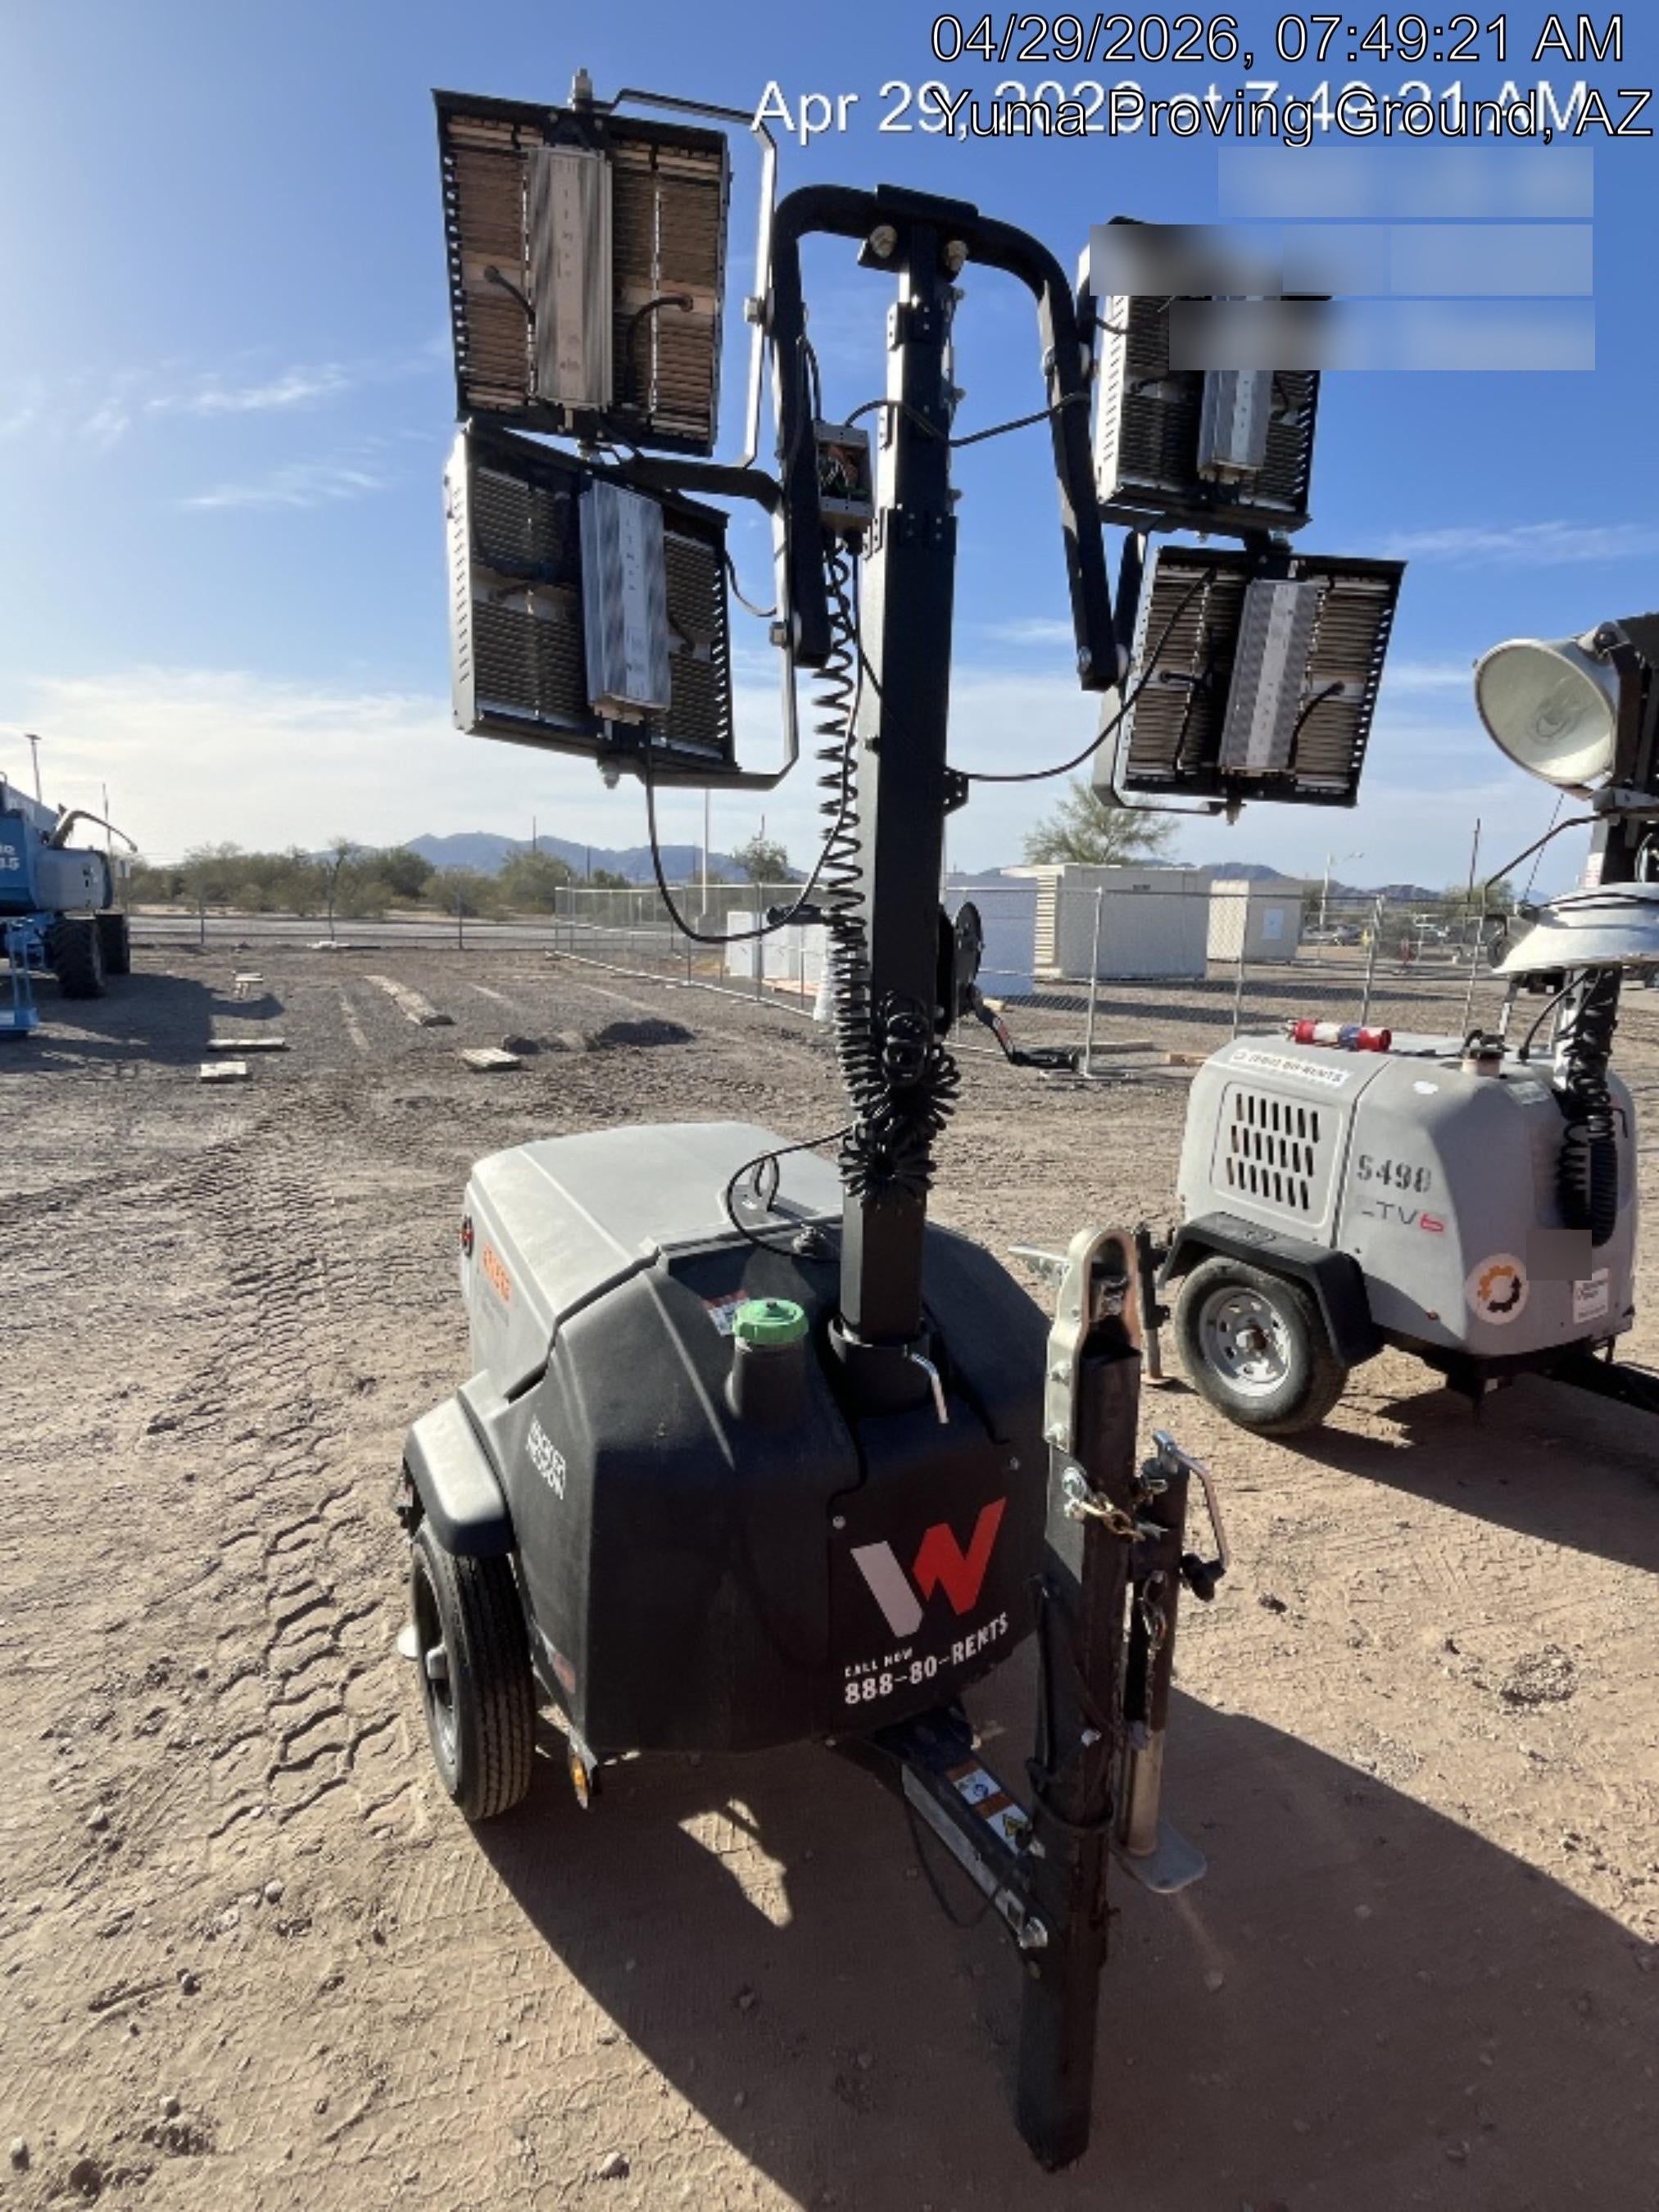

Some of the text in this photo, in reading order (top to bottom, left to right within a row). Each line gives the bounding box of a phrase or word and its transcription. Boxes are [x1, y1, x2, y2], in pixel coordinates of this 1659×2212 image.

[844, 1647, 913, 1679] CALL NOW
[845, 1611, 1009, 1705] 888-80-RENTS
